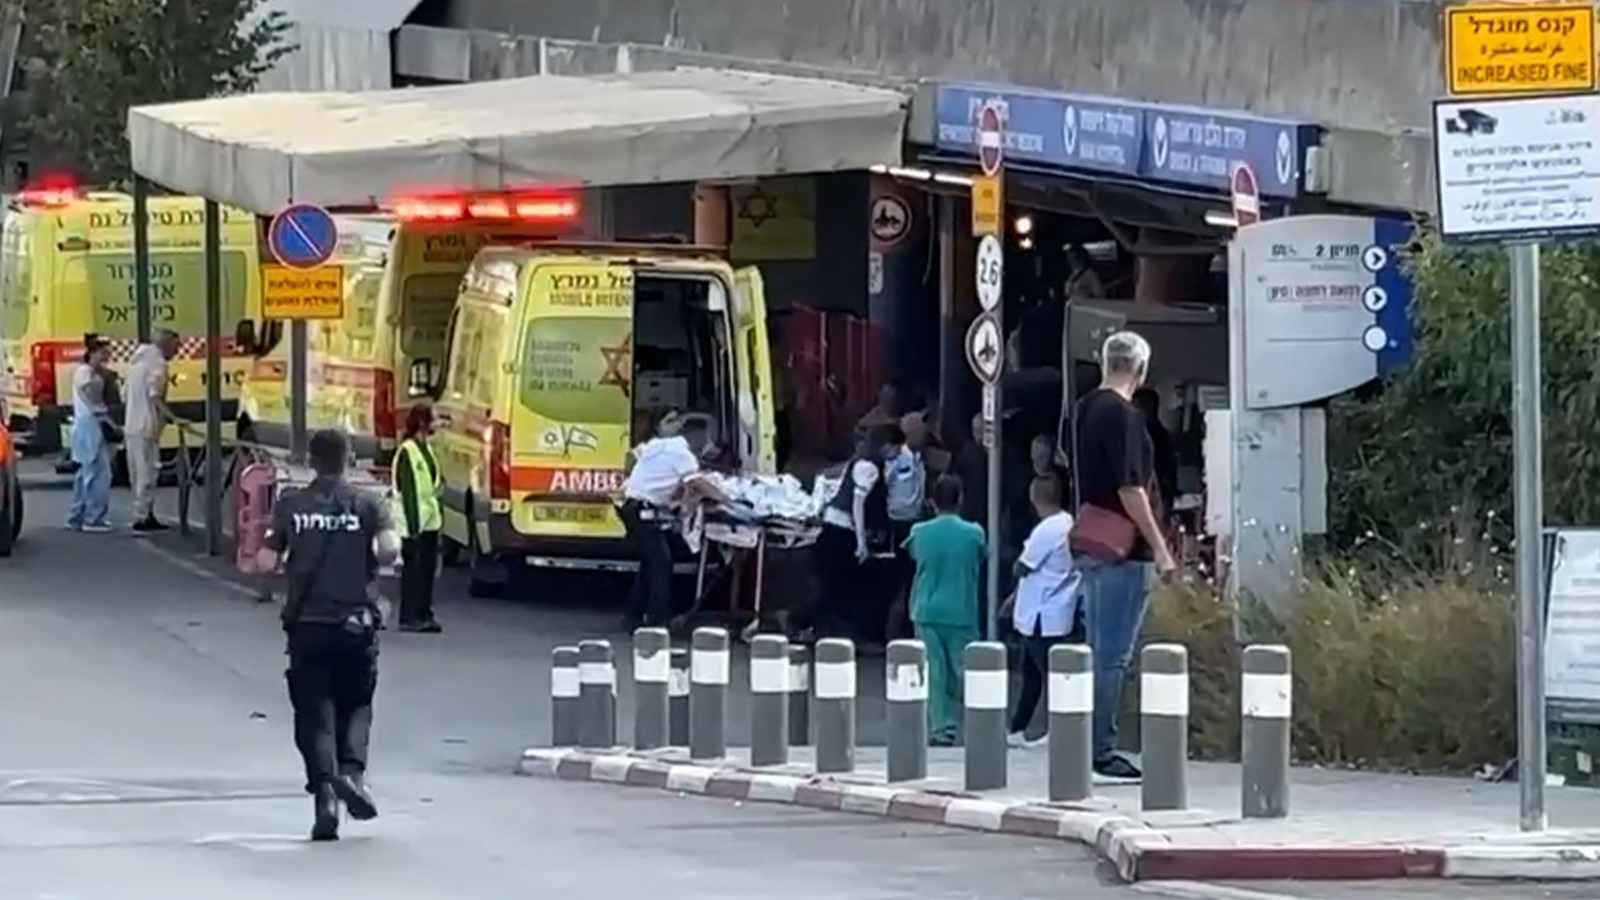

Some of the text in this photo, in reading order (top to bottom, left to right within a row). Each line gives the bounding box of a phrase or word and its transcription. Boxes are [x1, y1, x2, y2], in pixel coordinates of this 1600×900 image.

[1469, 16, 1576, 36] קנס מוגדל
[1457, 63, 1587, 83] INCREASED FINE
[1315, 243, 1325, 256] 2
[550, 274, 599, 290] נמרץ
[292, 513, 361, 534] ביטחון
